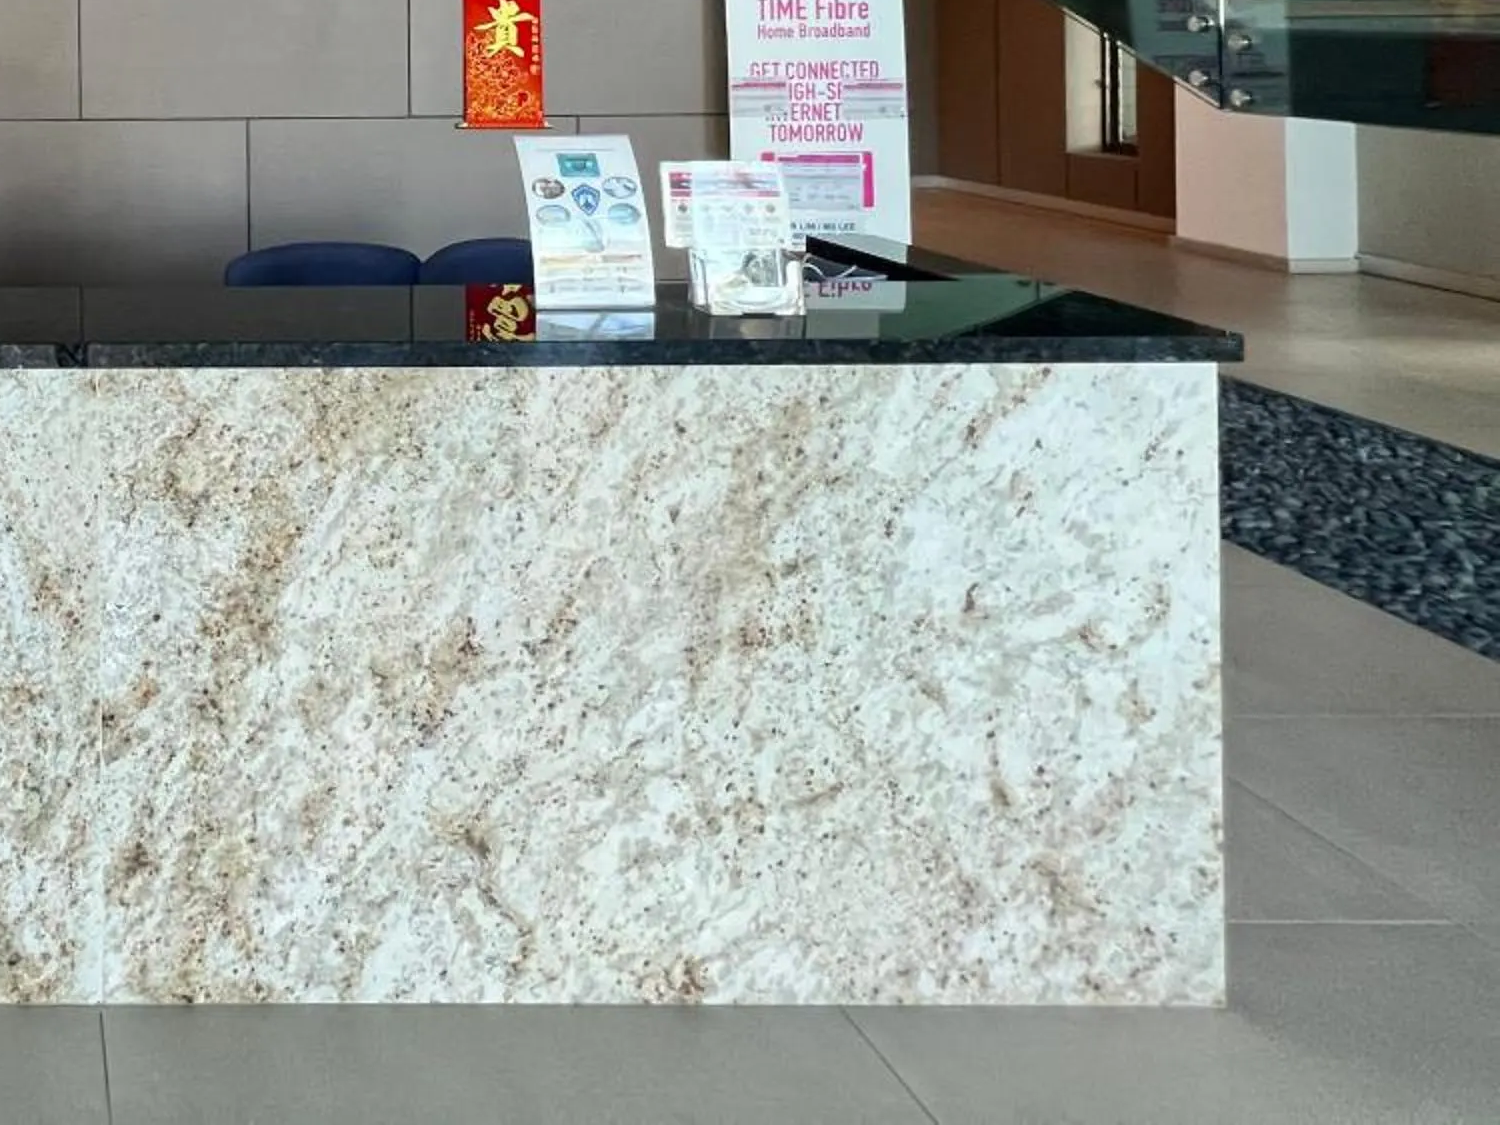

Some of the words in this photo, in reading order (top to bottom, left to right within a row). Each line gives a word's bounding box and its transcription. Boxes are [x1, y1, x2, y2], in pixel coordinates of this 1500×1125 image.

[757, 25, 794, 39] Home
[799, 23, 870, 38] Broadband
[750, 62, 781, 77] GET
[785, 61, 879, 79] CONNECTED
[770, 123, 864, 142] TOMORROW
